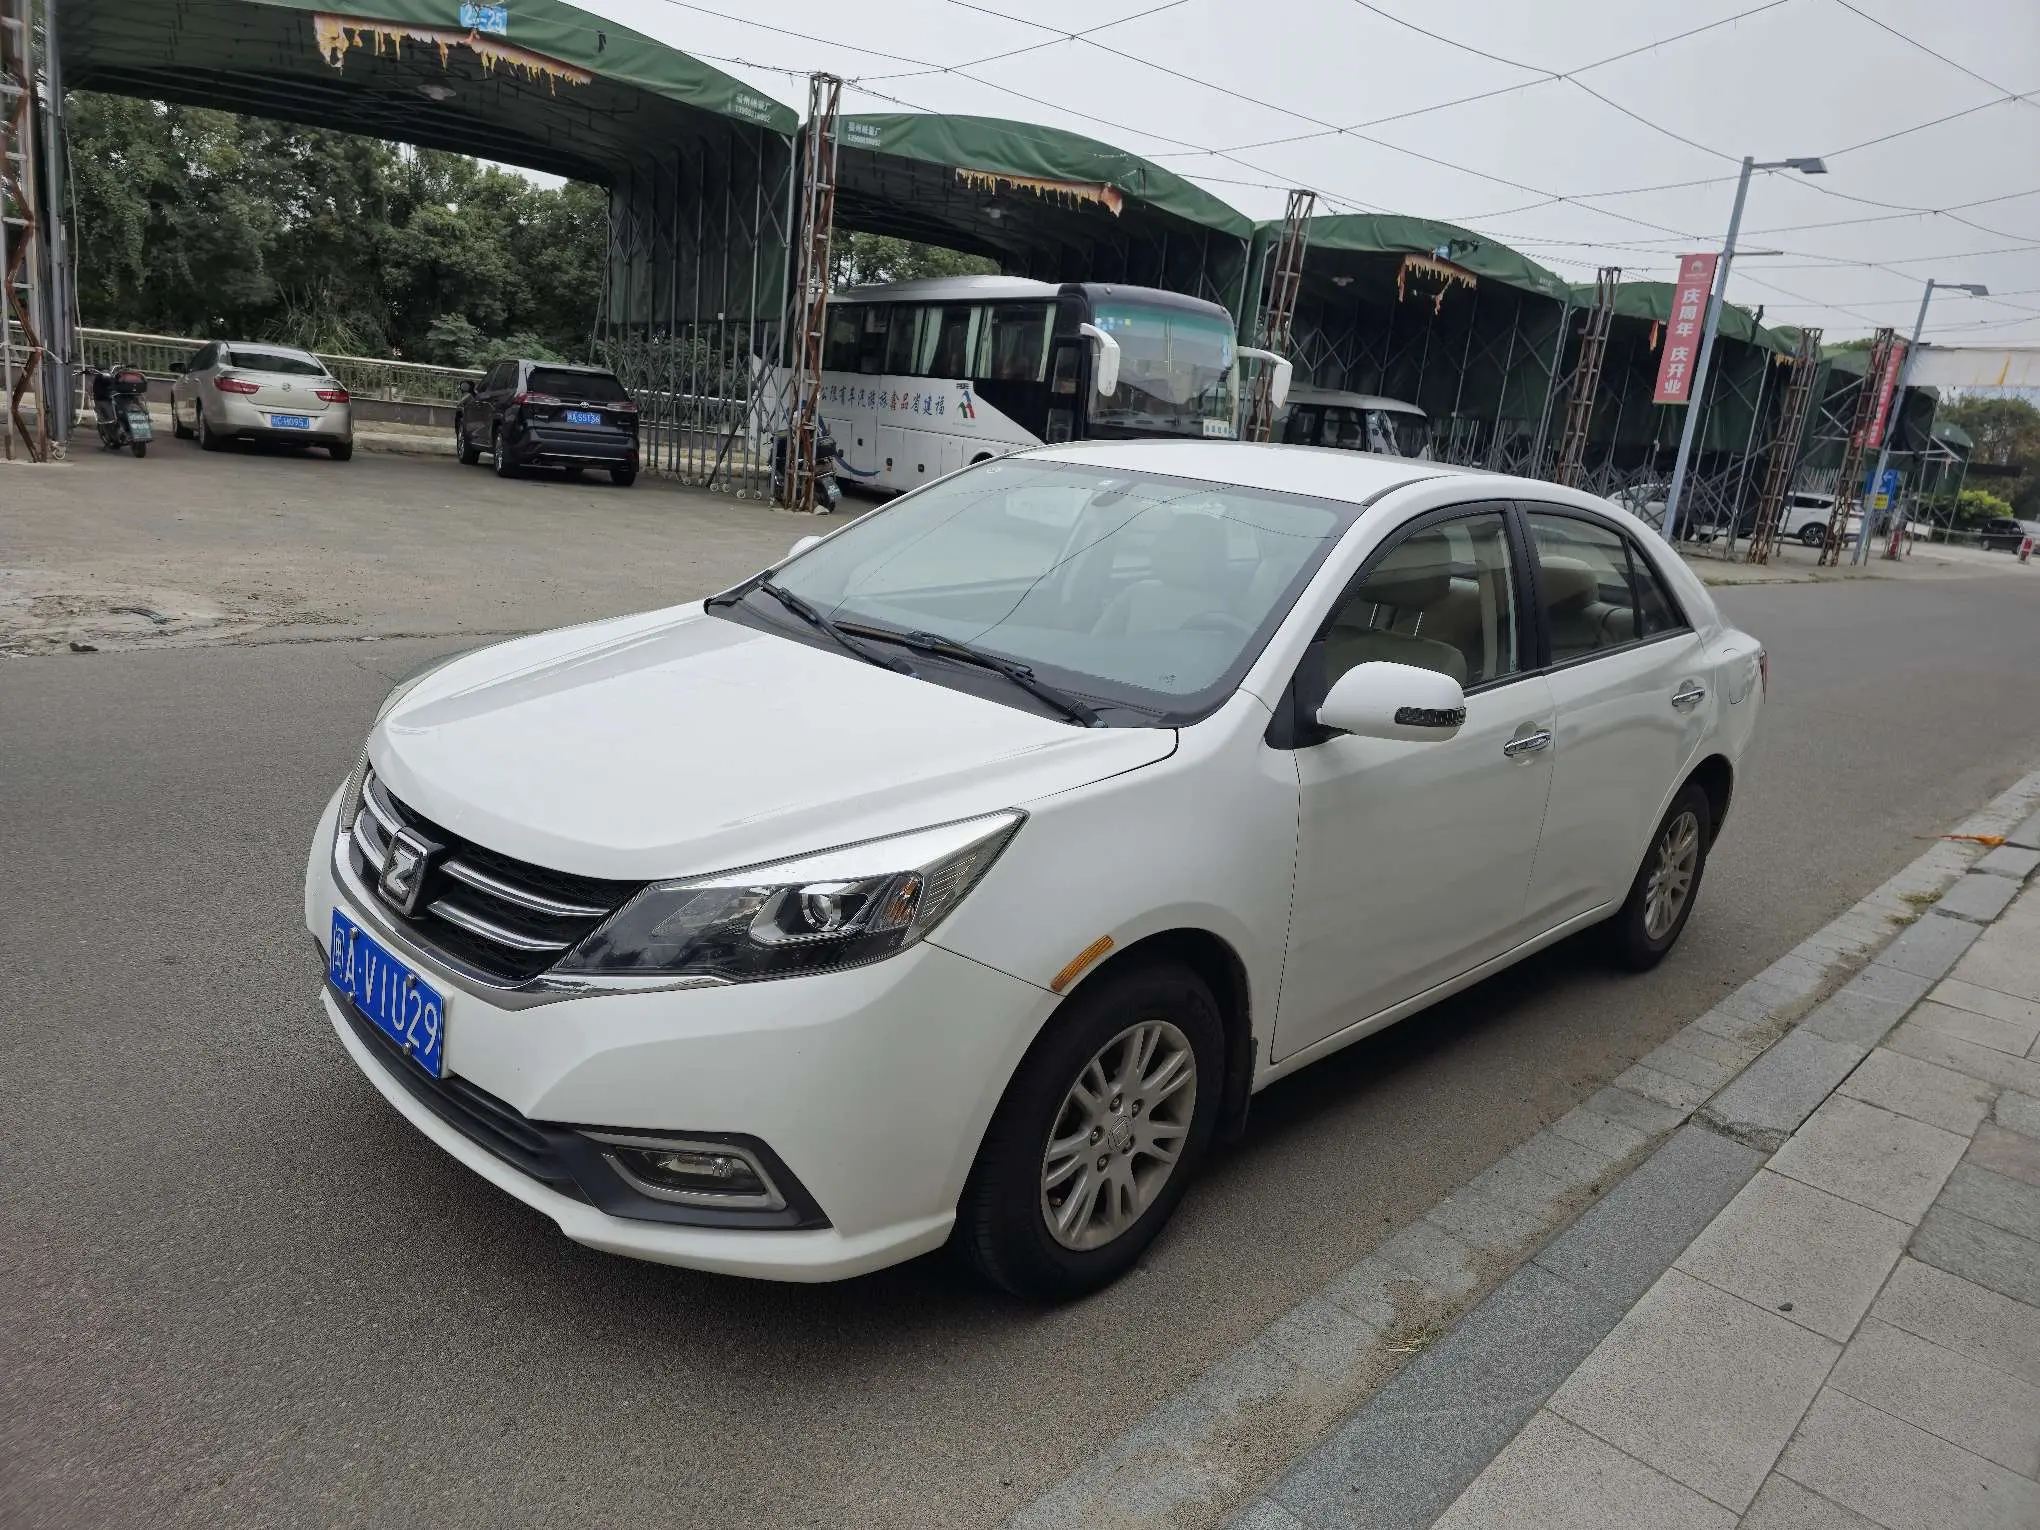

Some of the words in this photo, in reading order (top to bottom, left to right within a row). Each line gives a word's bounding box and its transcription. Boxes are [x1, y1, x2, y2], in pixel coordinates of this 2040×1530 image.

[1676, 288, 1701, 337] 庆周年
[1664, 347, 1689, 394] 庆开业
